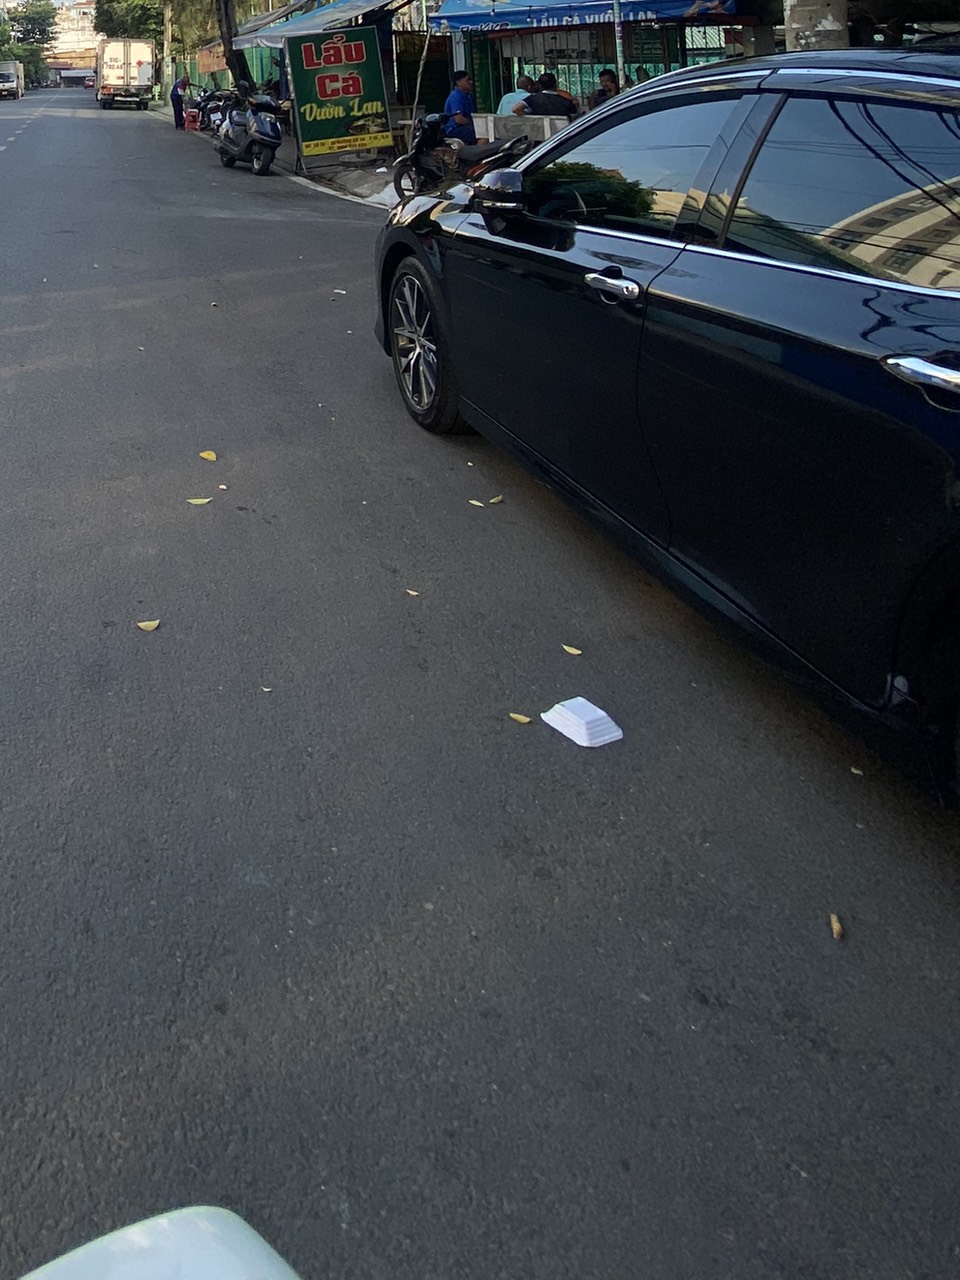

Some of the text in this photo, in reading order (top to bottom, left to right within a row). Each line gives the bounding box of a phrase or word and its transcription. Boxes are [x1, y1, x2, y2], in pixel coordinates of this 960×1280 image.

[301, 34, 367, 70] Lẩu
[315, 70, 364, 100] Cá
[349, 97, 385, 116] Lan
